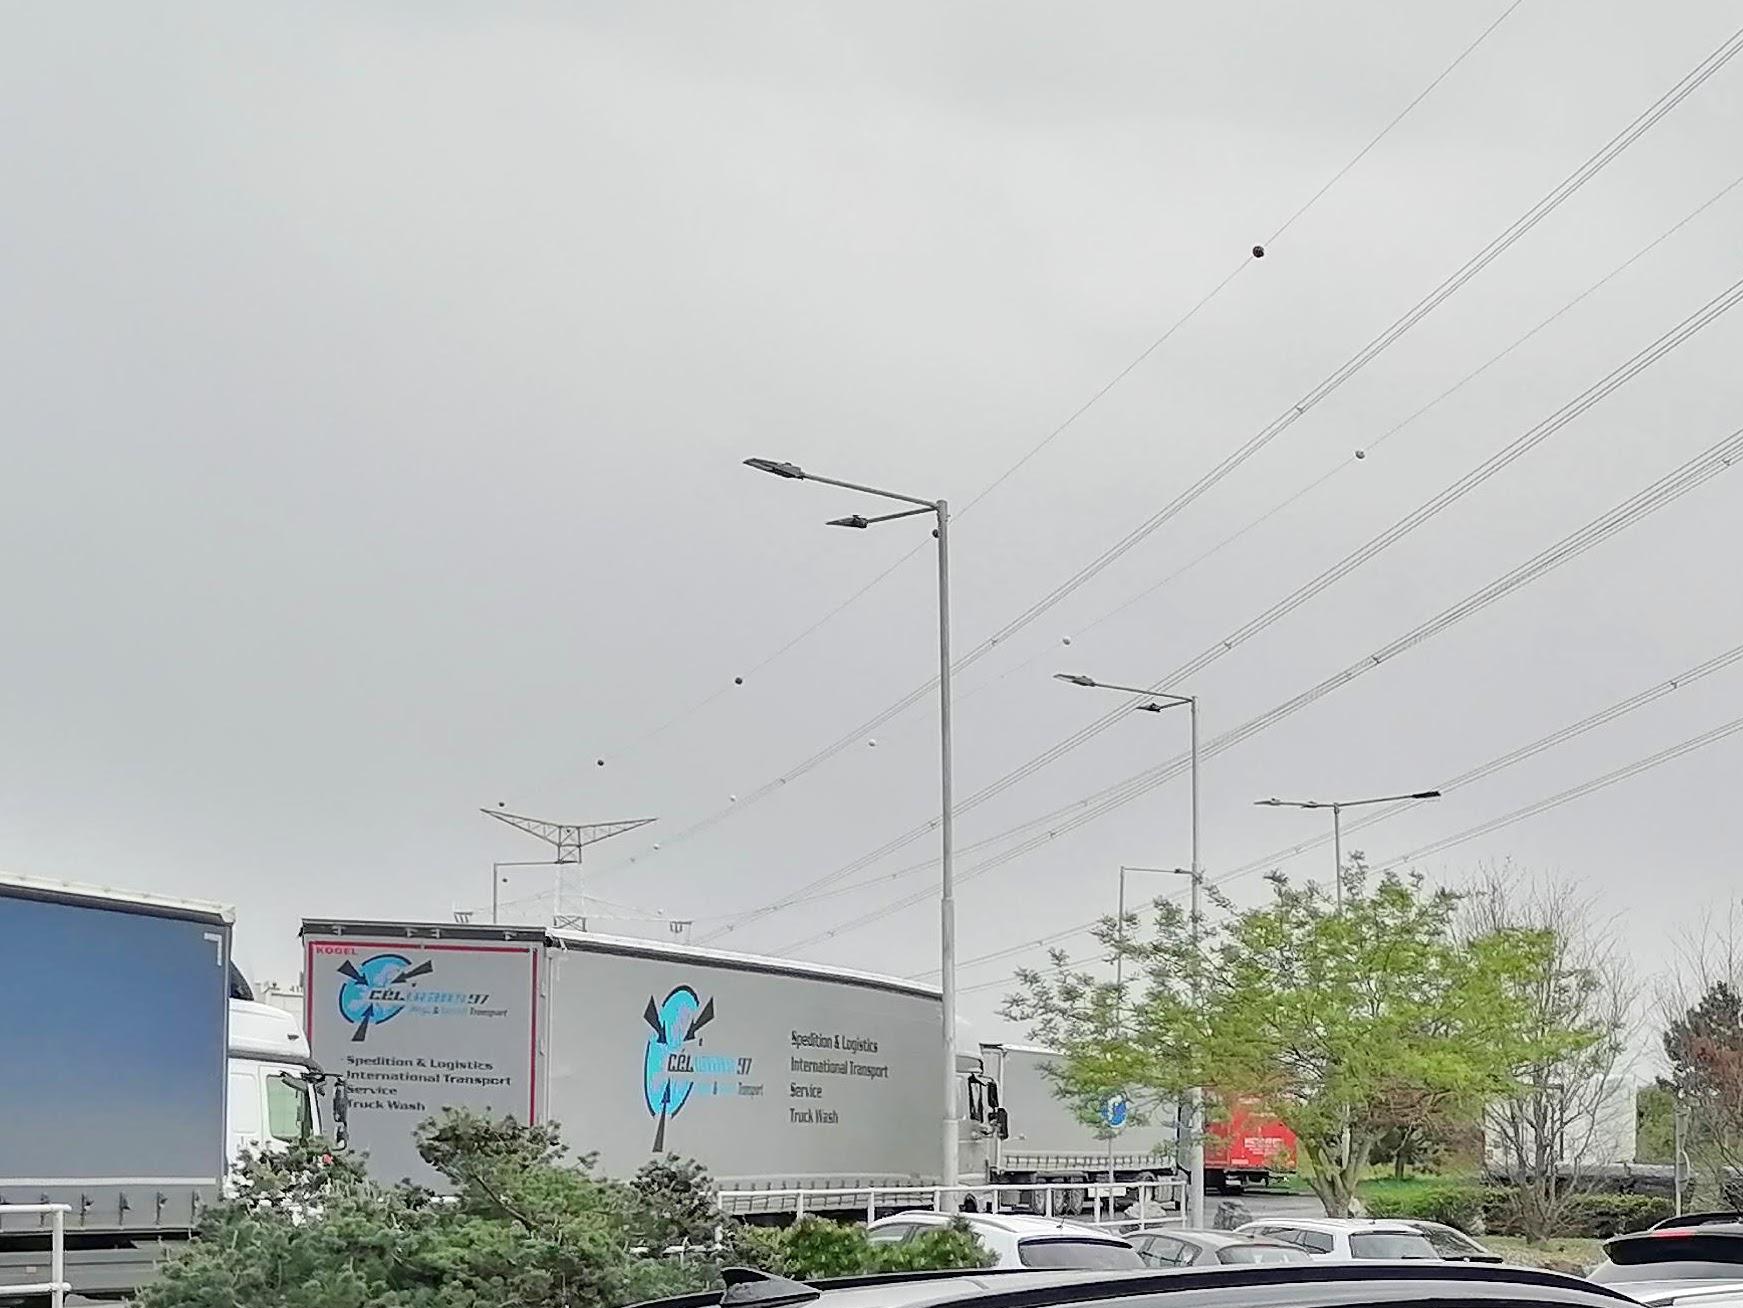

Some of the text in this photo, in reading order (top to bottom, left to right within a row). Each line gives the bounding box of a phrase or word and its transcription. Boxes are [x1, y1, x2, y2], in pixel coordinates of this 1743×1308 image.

[792, 1030, 878, 1054] Spedition & Logistics
[346, 1055, 493, 1071] Spedition & Logistics
[737, 1058, 752, 1075] 97
[791, 1056, 888, 1080] International Transport
[347, 1070, 511, 1086] International Transport
[346, 1084, 397, 1095] Service
[790, 1081, 822, 1098] Service
[388, 1100, 426, 1111] Wash
[790, 1107, 839, 1123] Truck Wash
